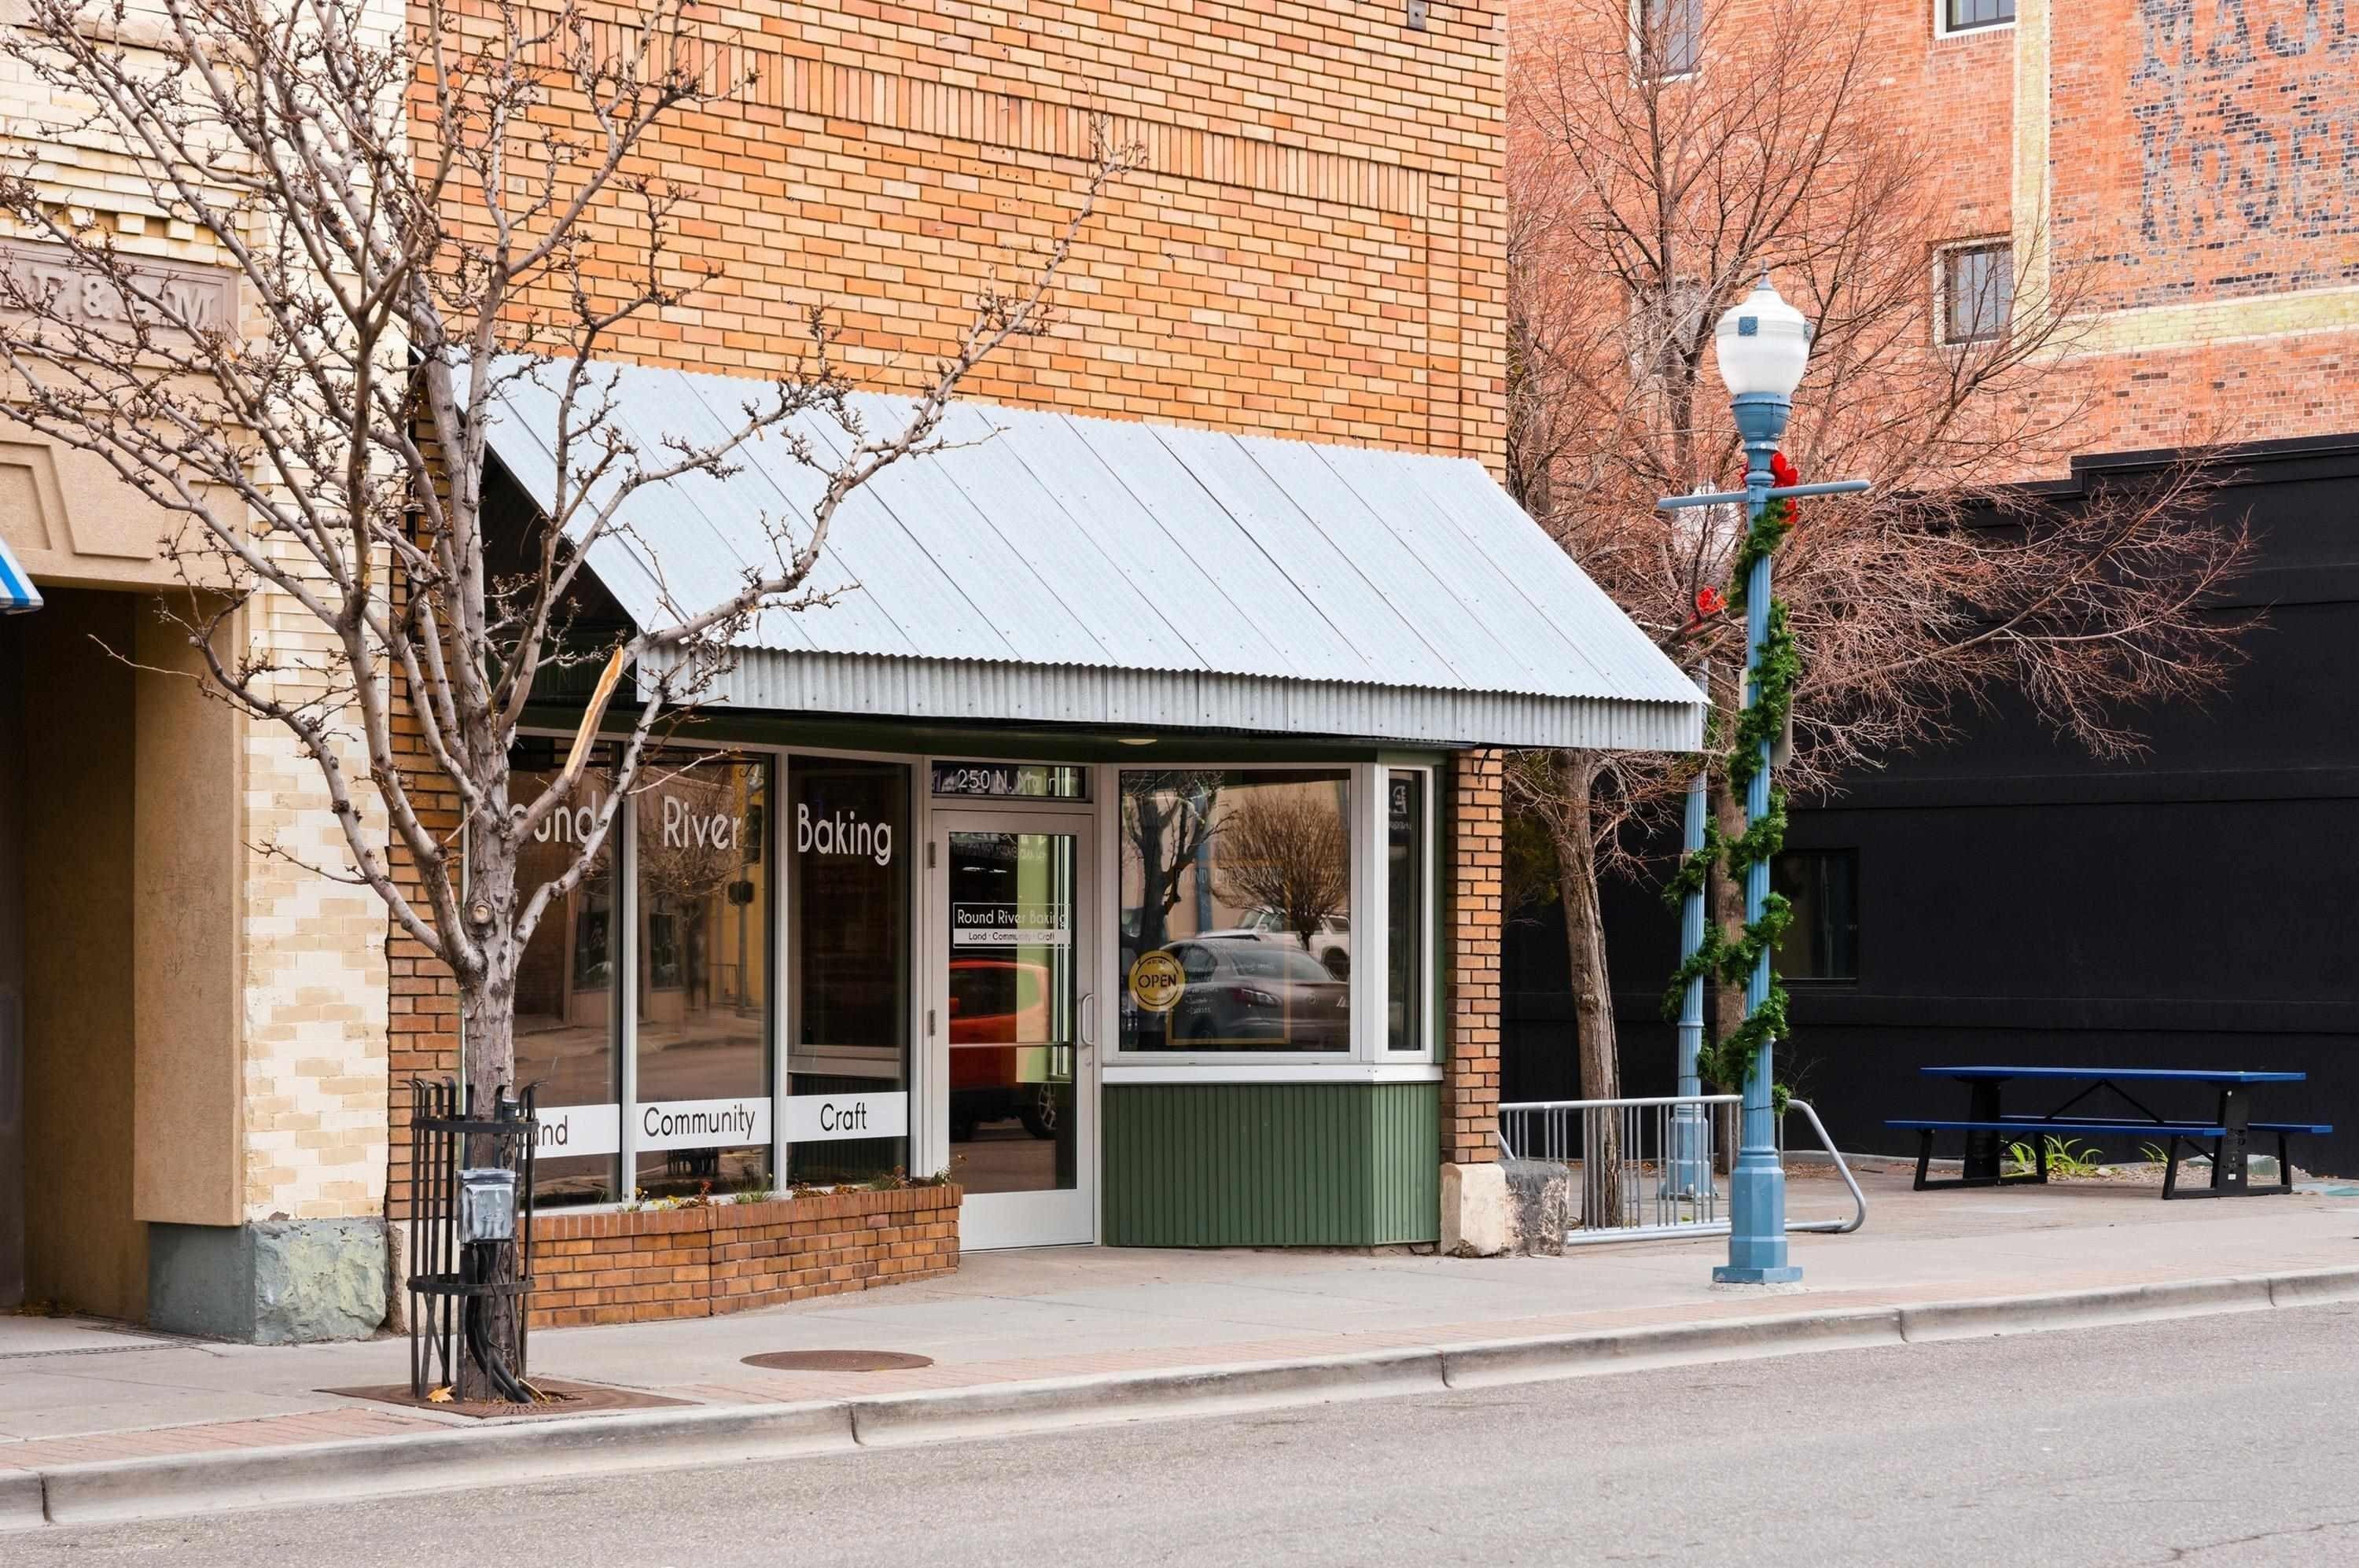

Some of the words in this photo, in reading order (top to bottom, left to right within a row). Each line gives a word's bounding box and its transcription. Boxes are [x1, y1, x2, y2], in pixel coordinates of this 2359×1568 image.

[957, 768, 991, 789] 250
[995, 769, 1013, 790] N.
[663, 796, 742, 850] River
[797, 803, 892, 866] Baking
[957, 909, 995, 924] Round
[998, 909, 1025, 925] River
[968, 932, 987, 940] Land
[1138, 974, 1177, 988] OPEN
[643, 1104, 756, 1140] Community
[819, 1102, 867, 1132] Craft
